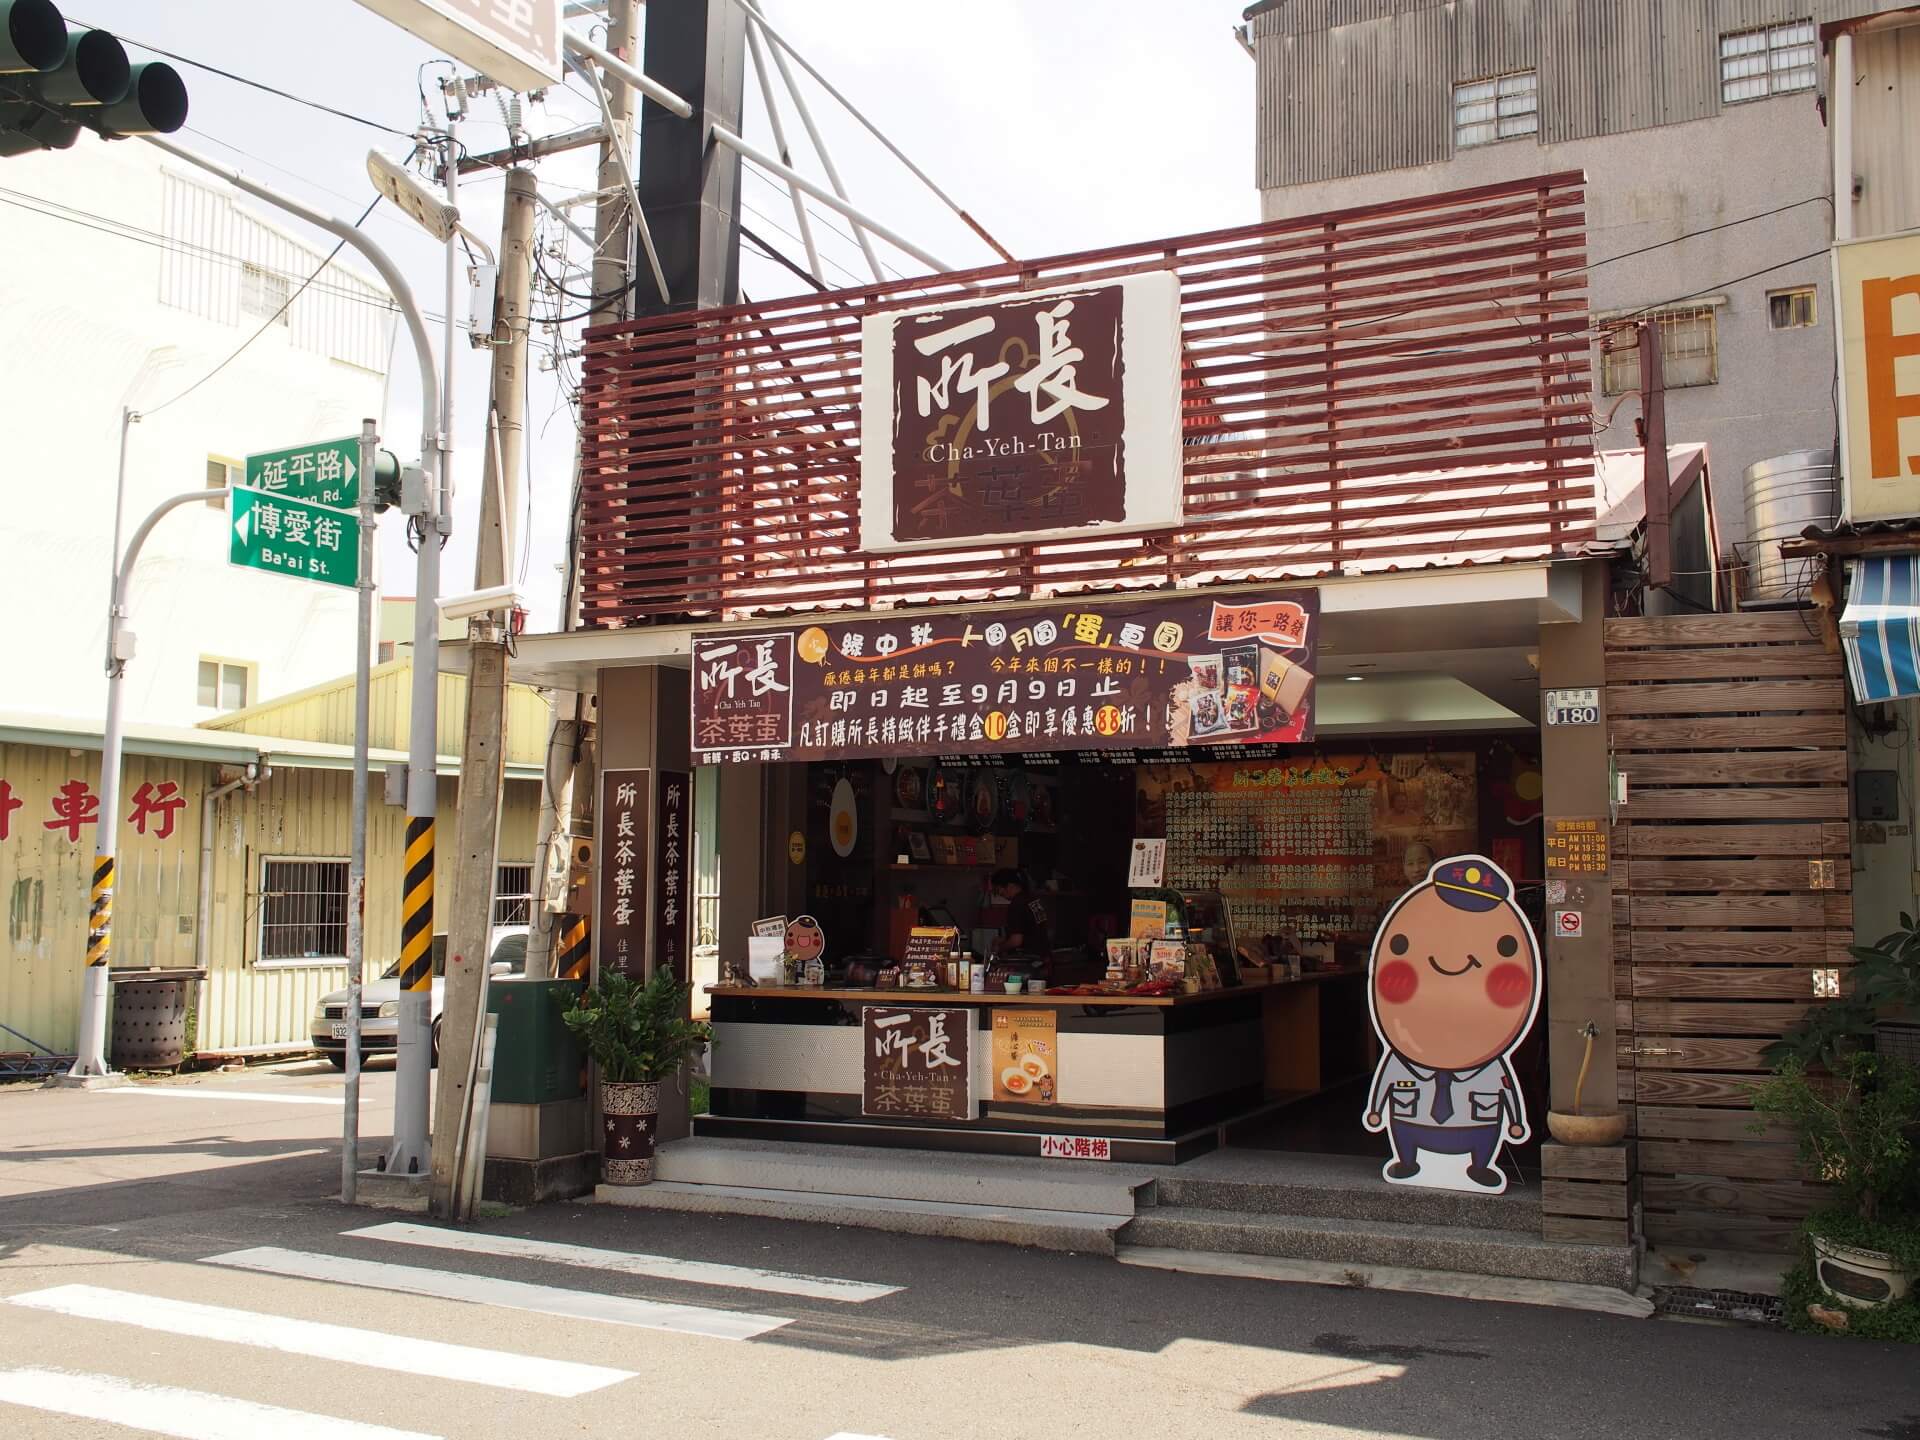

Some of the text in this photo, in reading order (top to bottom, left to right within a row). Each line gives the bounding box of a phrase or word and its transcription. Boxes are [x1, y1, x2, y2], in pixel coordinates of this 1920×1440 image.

[914, 299, 1109, 432] 所長
[929, 432, 1082, 464] Cha-Yeh-Tan
[263, 449, 342, 490] 延平路
[323, 489, 343, 503] Rd.
[251, 500, 342, 552] 博愛街
[262, 548, 330, 575] Ba'ai St.
[1216, 610, 1304, 637] 讓您一路發
[700, 640, 790, 699] 所長
[719, 699, 760, 710] Cha Yeh Tan
[1561, 708, 1595, 723] 180
[698, 713, 781, 744] 茶葉蛋
[1547, 838, 1566, 848] 平日
[1568, 834, 1605, 842] AM 11:00
[1568, 844, 1579, 852] PM
[613, 782, 637, 926] 所長茶葉蛋
[664, 783, 680, 926] 所長茶葉蛋
[1569, 853, 1579, 861] AM
[1569, 863, 1579, 871] PM
[874, 1012, 961, 1069] 所長
[881, 1071, 950, 1083] Cha-Yeh-Tan
[873, 1084, 954, 1114] 茶葉蛋
[1042, 1136, 1108, 1158] 小心階梯
